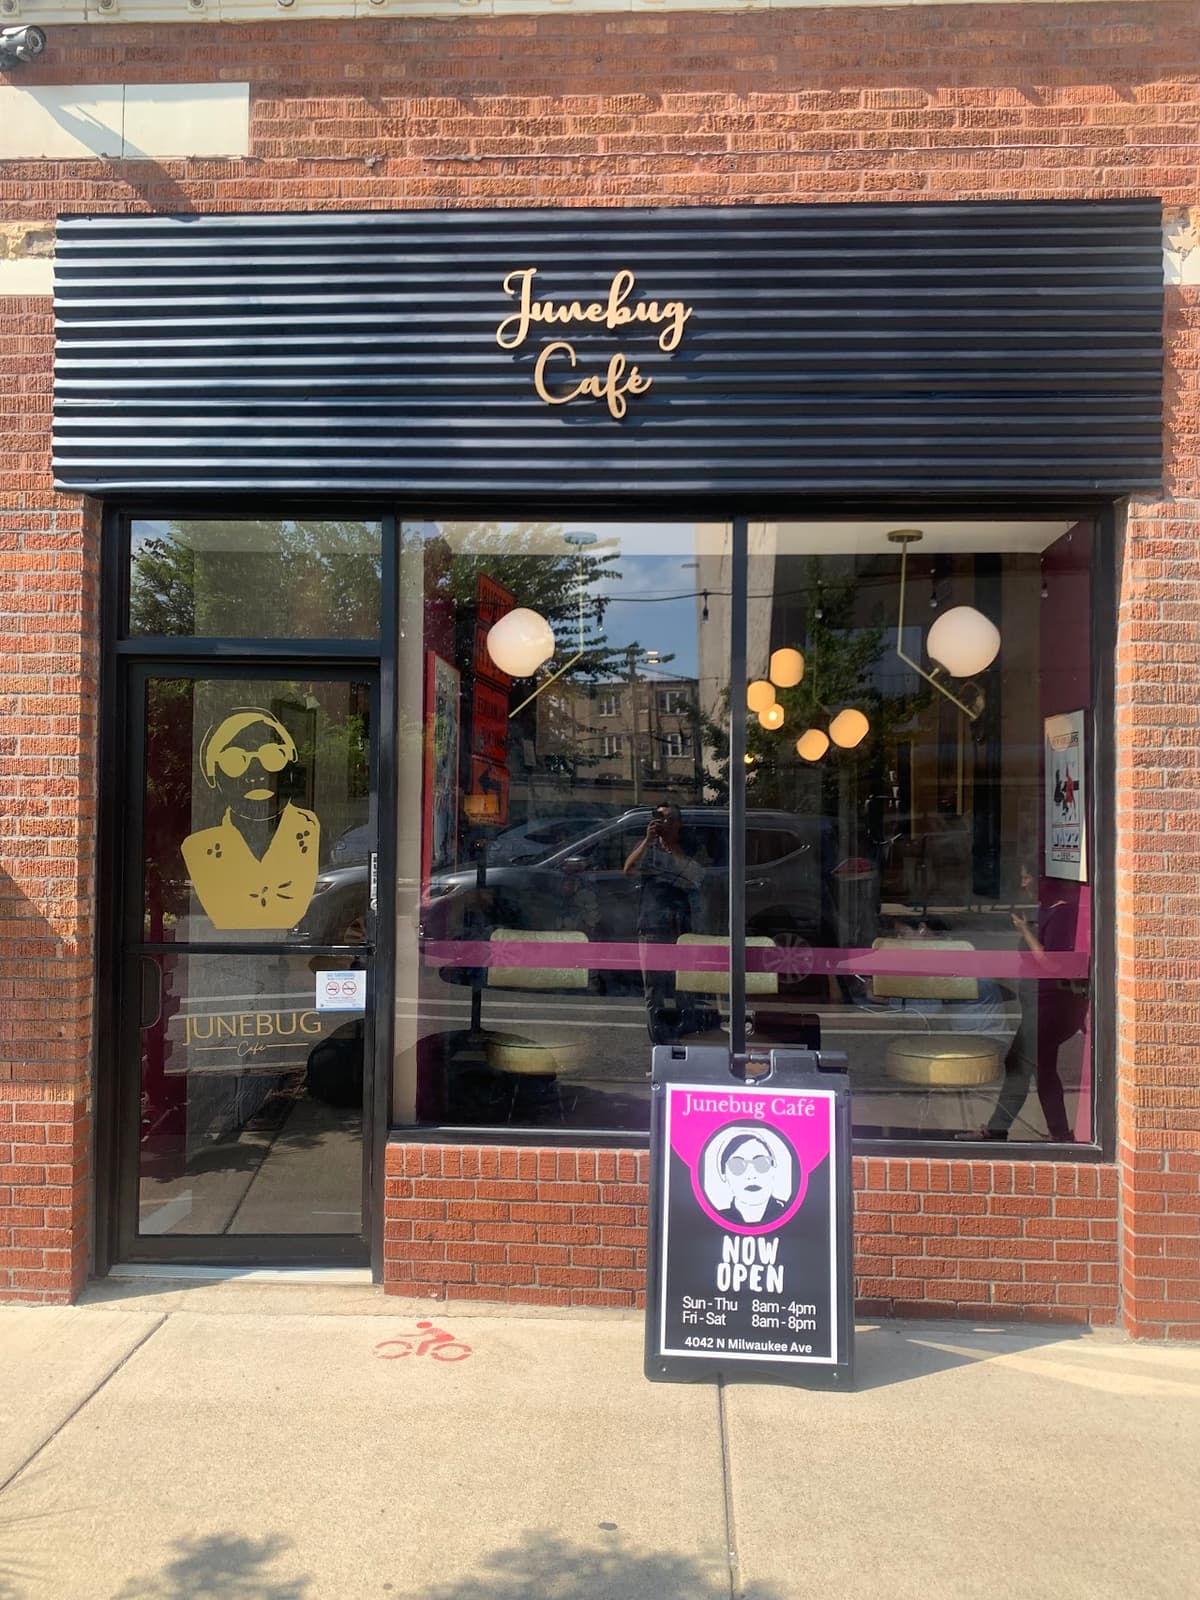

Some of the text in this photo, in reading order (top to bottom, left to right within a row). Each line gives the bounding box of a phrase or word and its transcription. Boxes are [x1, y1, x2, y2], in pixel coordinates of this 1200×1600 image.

[496, 268, 693, 351] Junebug
[534, 342, 653, 418] Café
[182, 1011, 322, 1046] JUNEBUG
[682, 1093, 816, 1120] Junebug Café
[722, 1235, 780, 1266] NOW
[717, 1262, 785, 1294] OPEN
[684, 1336, 812, 1354] 4042 N Milwaukee Ave
